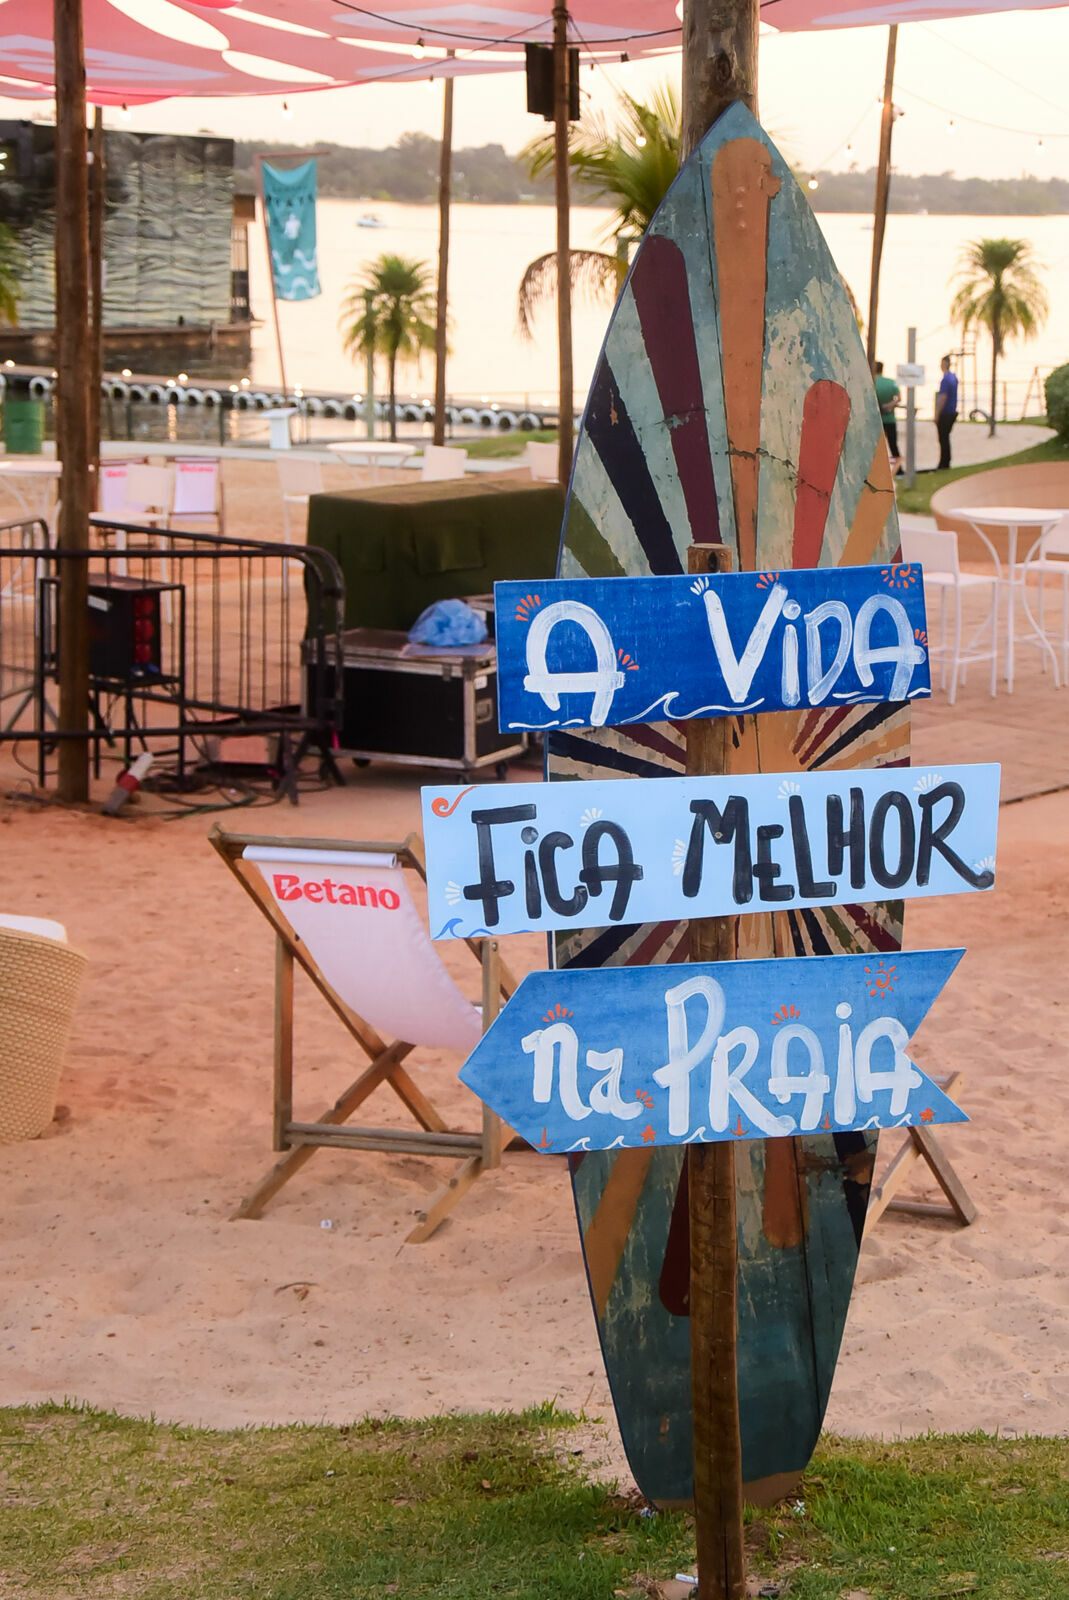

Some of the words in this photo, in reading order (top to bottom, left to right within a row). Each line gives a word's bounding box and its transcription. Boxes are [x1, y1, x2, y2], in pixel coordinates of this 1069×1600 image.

[523, 600, 625, 726] A
[273, 873, 400, 910] Betano
[682, 781, 995, 905] MELHOR
